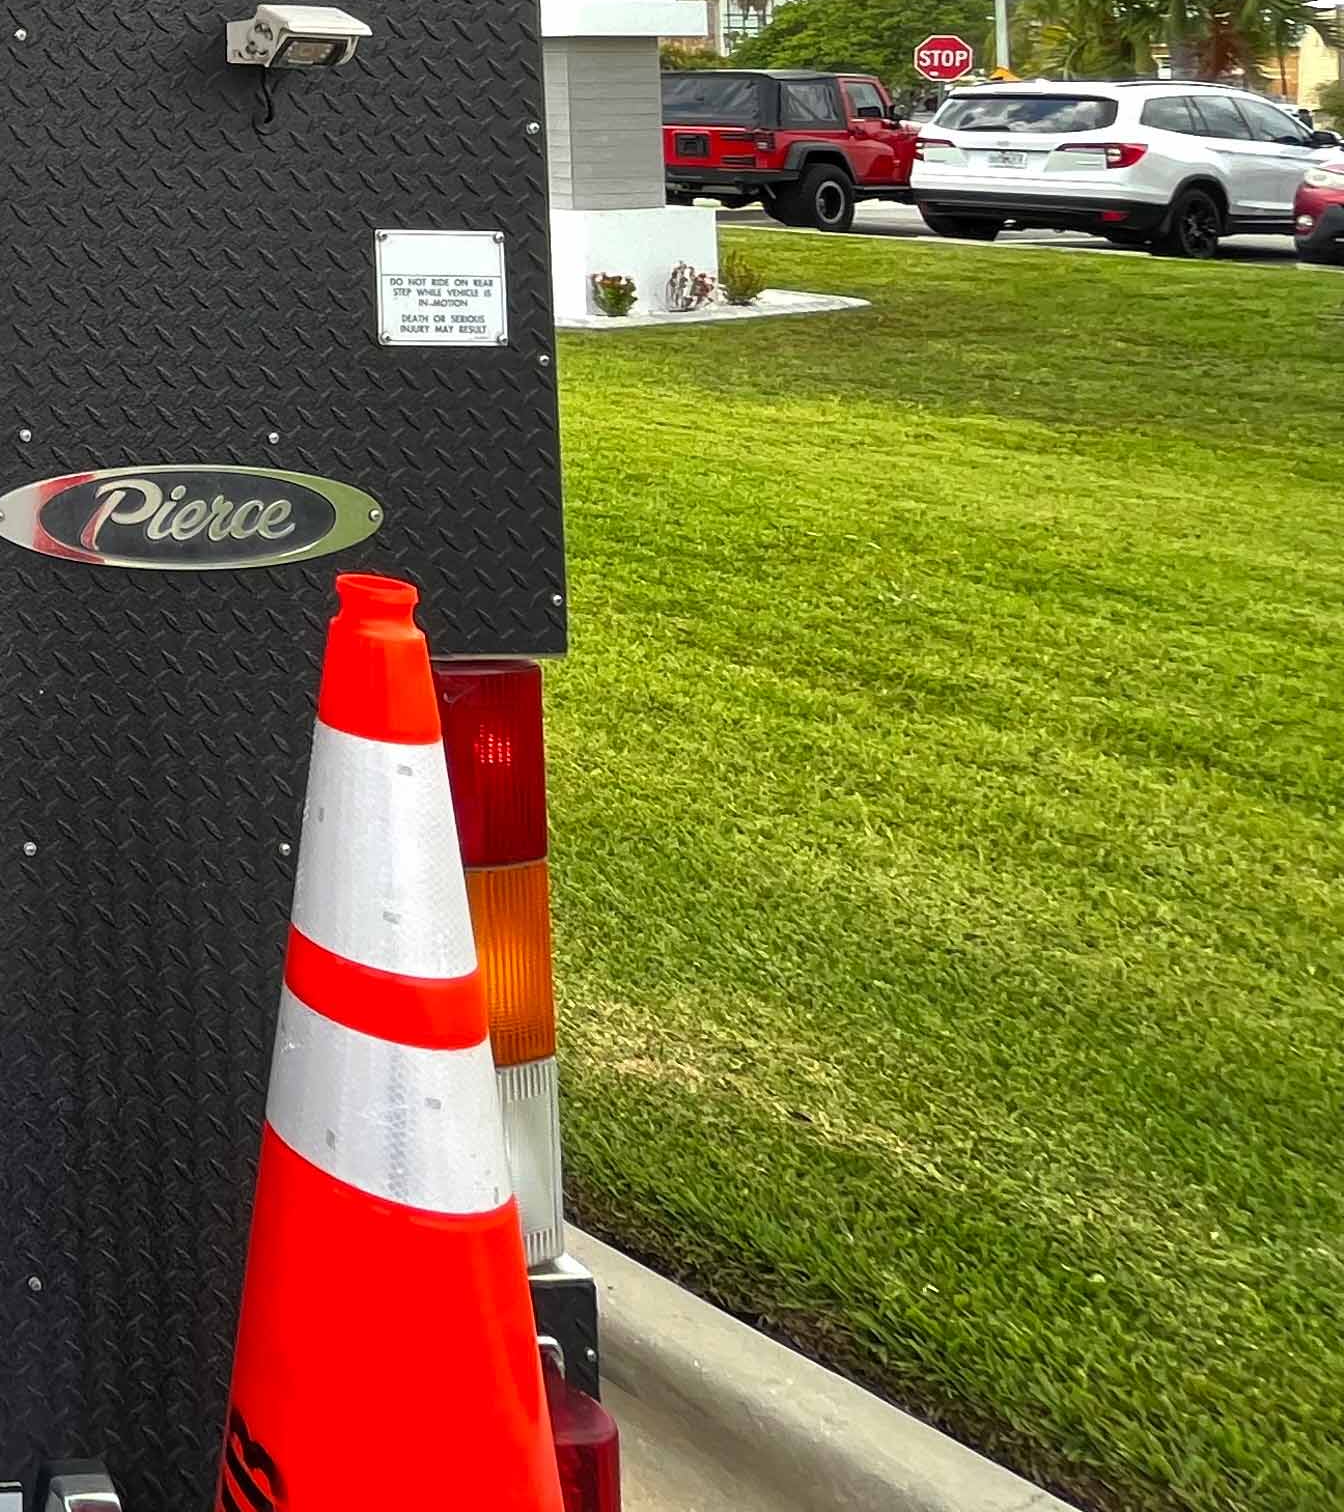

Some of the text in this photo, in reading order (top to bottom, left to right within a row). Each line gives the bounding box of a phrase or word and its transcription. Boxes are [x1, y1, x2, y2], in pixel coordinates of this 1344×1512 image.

[919, 50, 968, 67] STOP
[390, 278, 493, 287] DO NOT RIDE ON REAR
[393, 288, 492, 297] STEP WHILE VEHICLE IS
[401, 314, 485, 323] DEATH OR SERIOUS
[399, 324, 487, 333] INJURY MAY RESULT
[79, 478, 297, 551] Pierce
